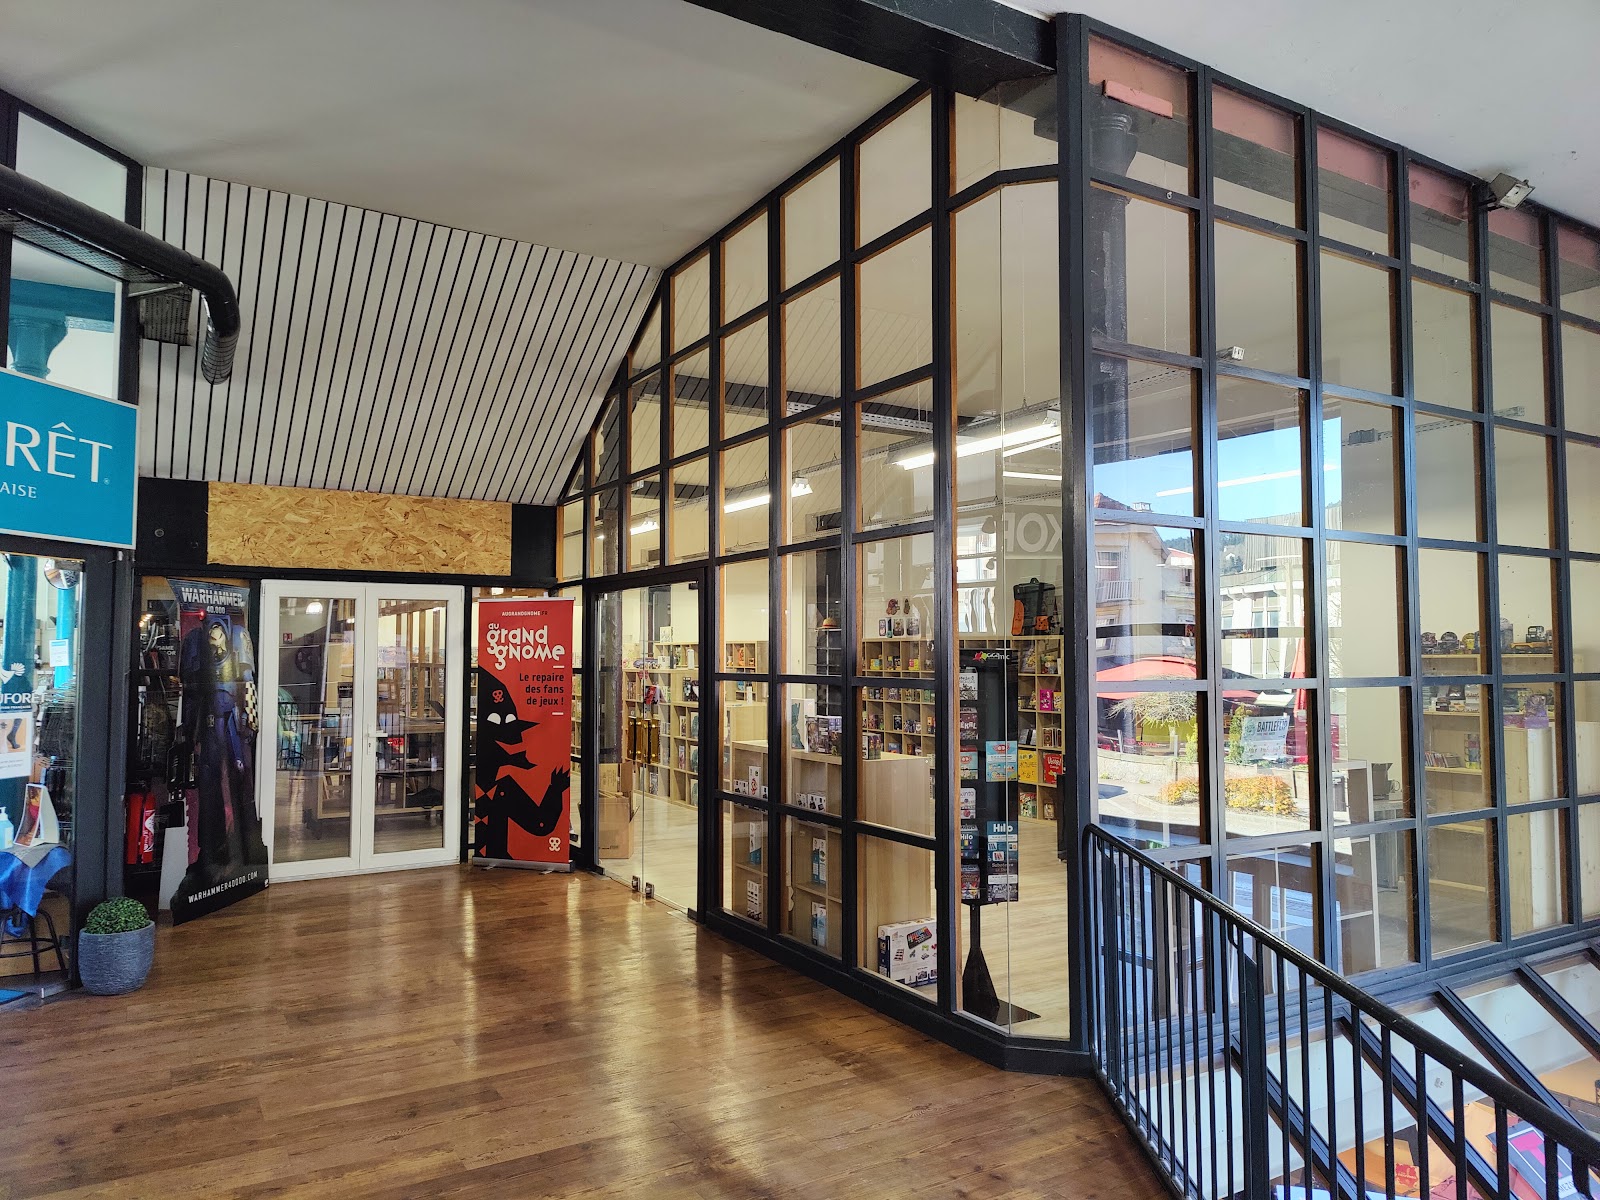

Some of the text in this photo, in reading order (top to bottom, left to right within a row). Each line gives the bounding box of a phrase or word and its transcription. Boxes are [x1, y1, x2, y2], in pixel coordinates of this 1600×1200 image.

[5, 420, 113, 483] RÊT
[0, 481, 37, 499] AISE
[182, 587, 245, 607] WARHAMMER
[519, 673, 564, 684] Le repaire
[525, 685, 564, 694] des fans
[526, 697, 537, 705] de
[539, 697, 559, 707] jeux
[993, 823, 1014, 833] Hilo
